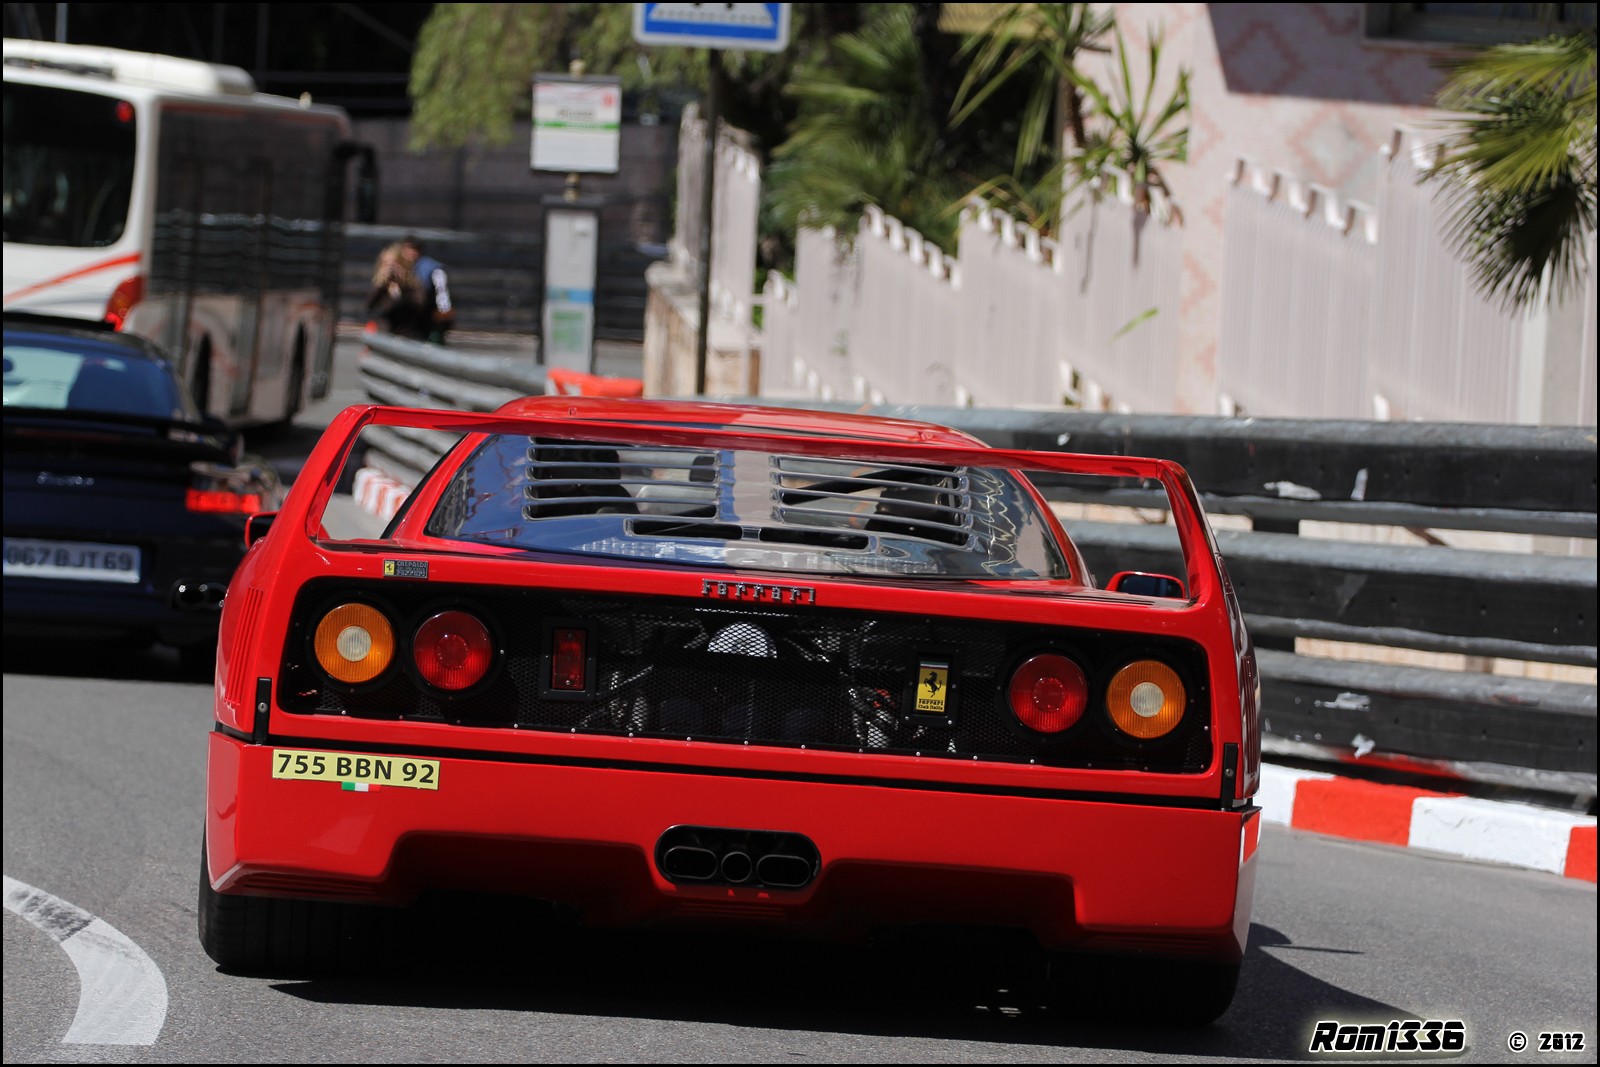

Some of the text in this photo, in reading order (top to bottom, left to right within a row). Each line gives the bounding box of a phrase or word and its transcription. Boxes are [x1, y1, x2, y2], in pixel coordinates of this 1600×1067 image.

[702, 579, 815, 602] Ferrari
[918, 698, 944, 706] Ferrari
[278, 753, 434, 784] 755 BBN 92
